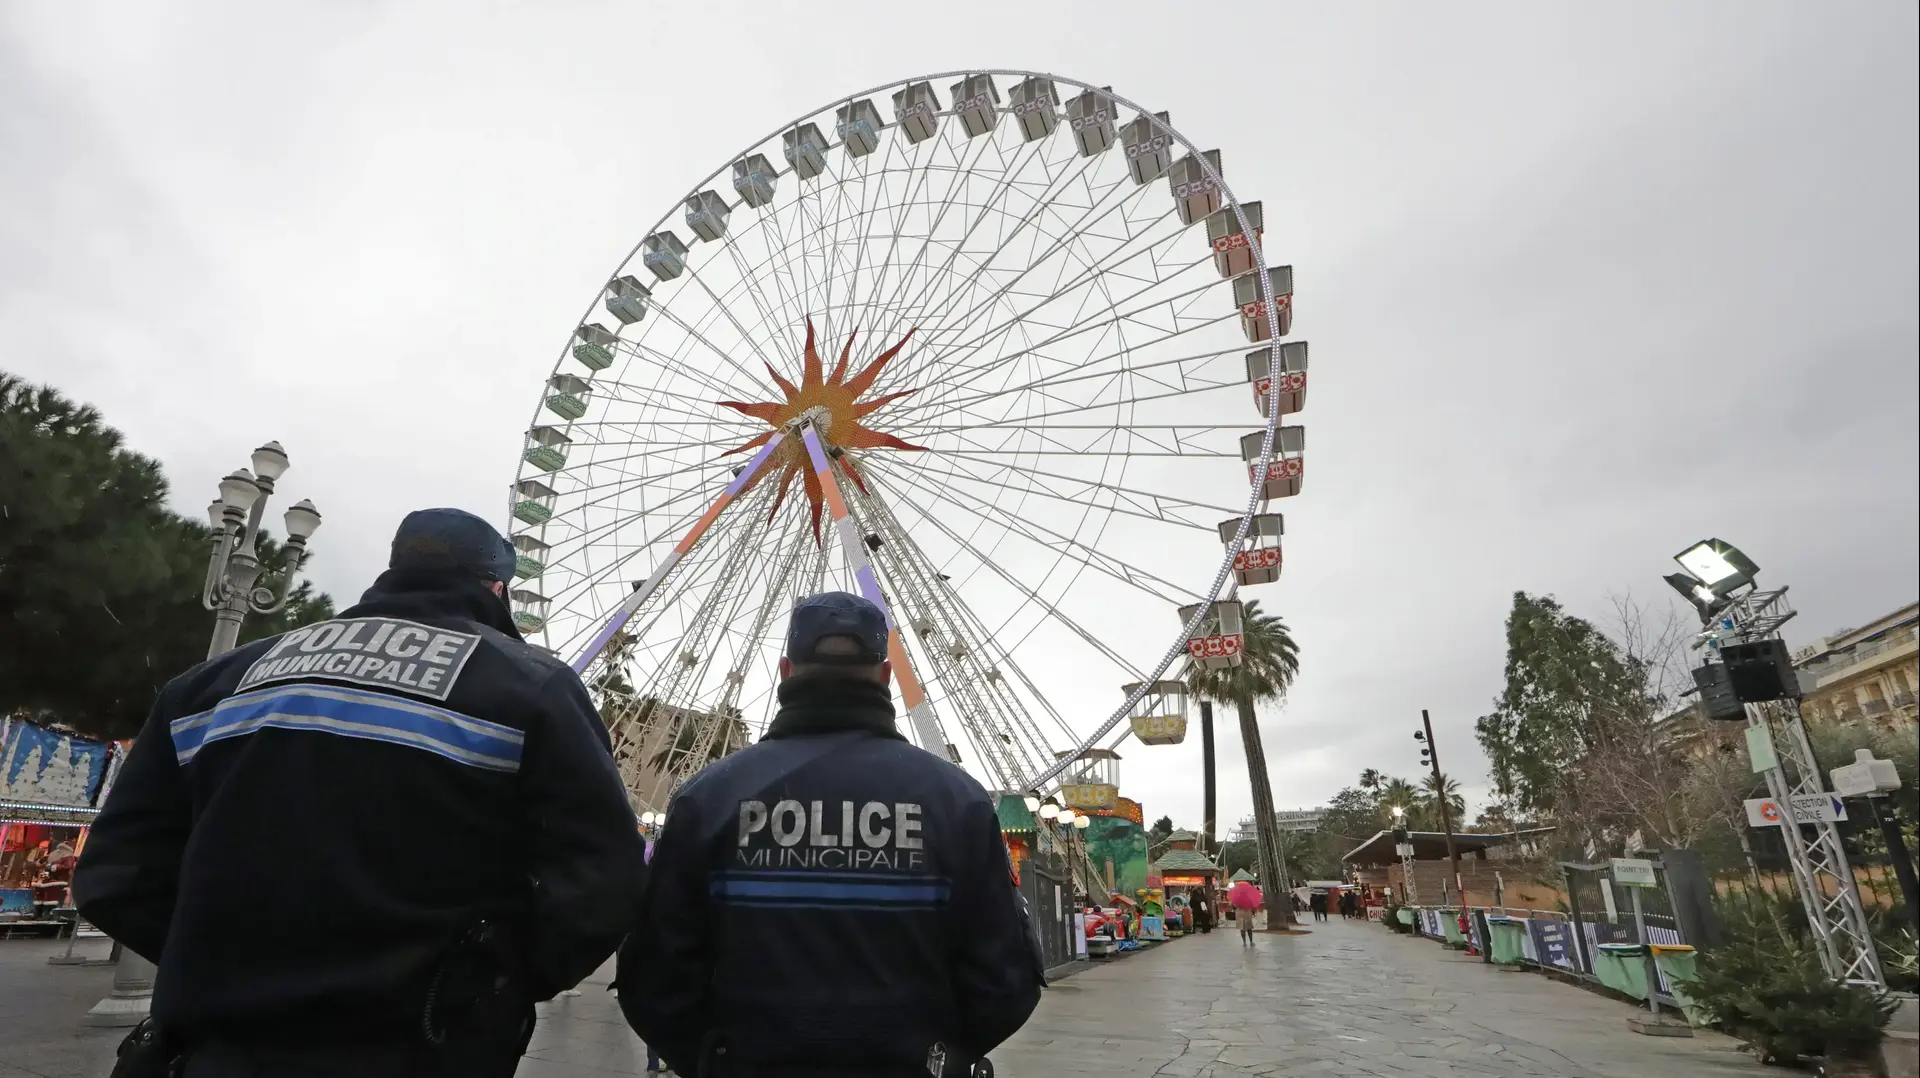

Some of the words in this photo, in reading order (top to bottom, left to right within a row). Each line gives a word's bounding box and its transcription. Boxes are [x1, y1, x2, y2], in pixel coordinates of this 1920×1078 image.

[270, 621, 466, 664] POLICE
[249, 652, 445, 690] MUNICIPALE
[1791, 796, 1829, 808] TECTION
[738, 799, 924, 849] POLICE
[737, 848, 925, 869] MUNICIPALE
